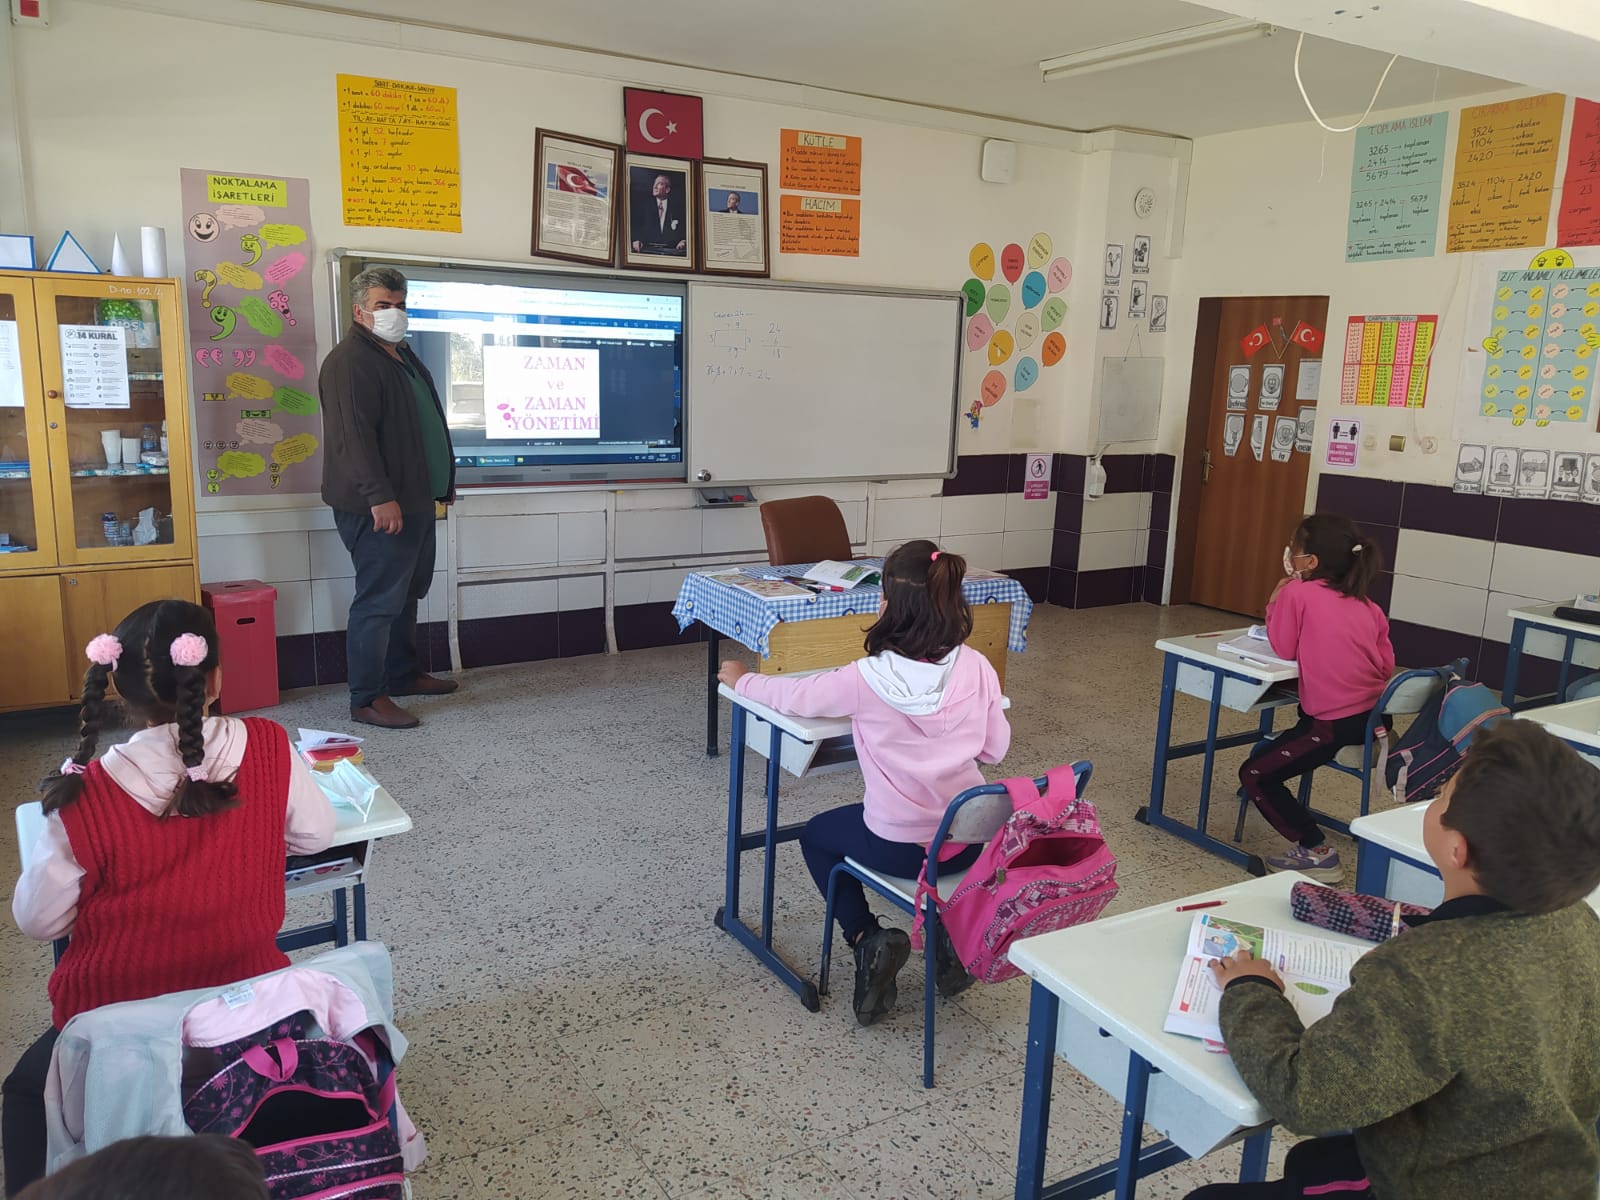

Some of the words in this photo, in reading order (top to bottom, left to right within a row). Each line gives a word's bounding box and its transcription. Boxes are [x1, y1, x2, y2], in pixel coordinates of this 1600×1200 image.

[1369, 122, 1406, 135] TOPLAMA
[1471, 126, 1494, 138] 3524
[1471, 137, 1493, 149] 1104
[1369, 145, 1389, 157] 3265
[1467, 150, 1494, 163] 2420
[1367, 157, 1387, 168] 2414
[1366, 170, 1388, 181] 5679
[1518, 171, 1542, 181] 2420
[213, 177, 278, 190] NOKTALAMA
[213, 191, 274, 202] İŞARETLERİ
[1356, 200, 1373, 208] 3265
[1410, 194, 1428, 202] 5679
[1500, 271, 1518, 282] ZIT
[1520, 271, 1554, 281] ANLAMLI
[768, 322, 781, 334] 24
[89, 332, 118, 340] KURAL
[524, 355, 586, 370] ZAMAN
[548, 380, 564, 390] ve
[525, 396, 586, 410] ZAMAN
[511, 413, 600, 430] YÖNETİMİ
